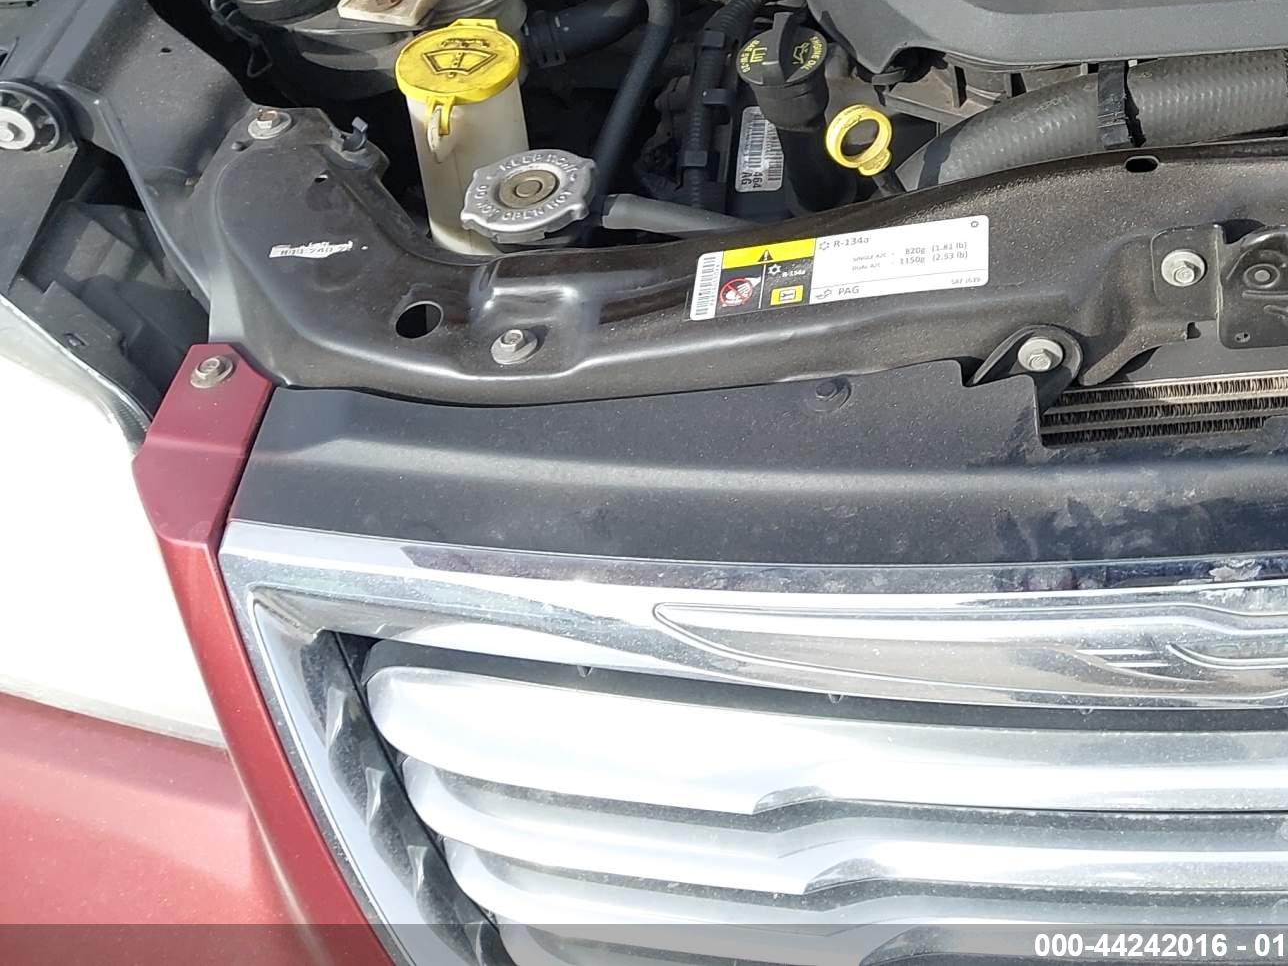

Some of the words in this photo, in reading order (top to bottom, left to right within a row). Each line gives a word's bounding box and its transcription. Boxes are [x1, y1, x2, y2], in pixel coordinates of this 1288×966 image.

[809, 36, 824, 59] ENGINE
[800, 57, 817, 72] OIL
[500, 154, 542, 171] KEEP
[502, 208, 545, 221] OPEN
[833, 236, 870, 248] R-134a
[905, 246, 926, 256] 820g
[956, 241, 967, 250] lb)
[838, 285, 860, 296] PAG
